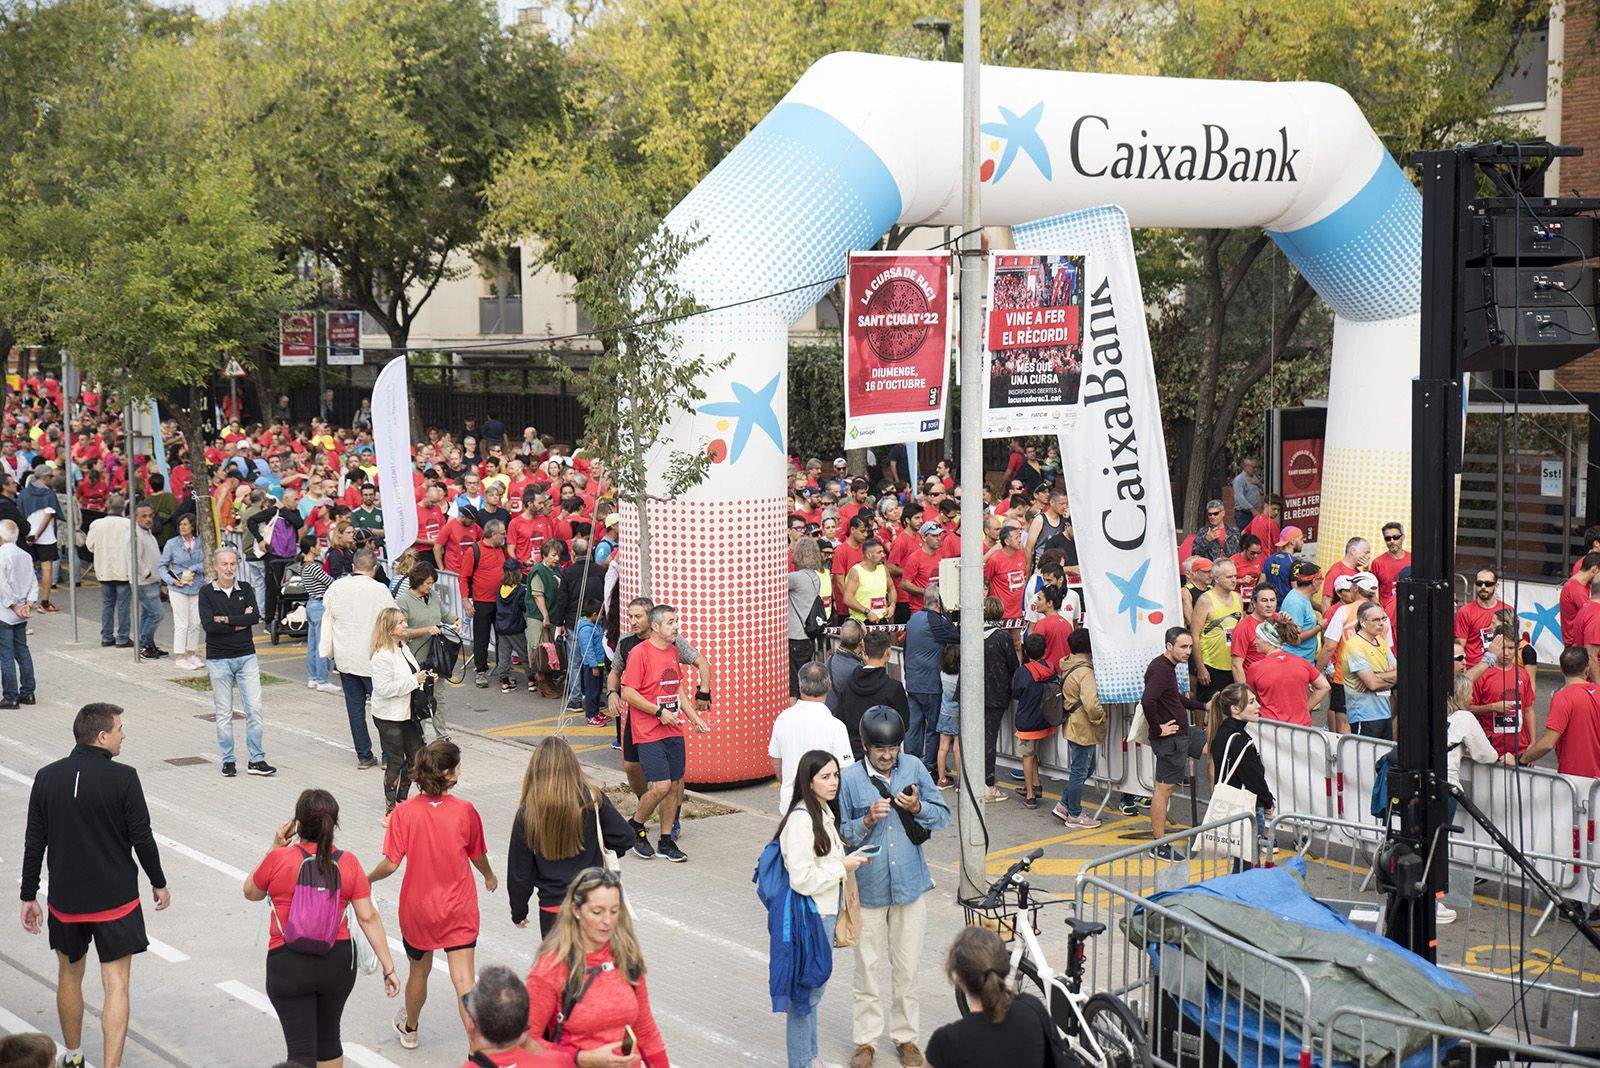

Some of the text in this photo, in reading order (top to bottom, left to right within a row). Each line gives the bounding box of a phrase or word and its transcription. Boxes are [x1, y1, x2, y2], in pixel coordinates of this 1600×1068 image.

[1069, 114, 1301, 183] CaixaBank
[860, 288, 874, 305] LA
[870, 266, 903, 291] CURSA
[903, 267, 917, 280] DE
[857, 314, 886, 328] SANT
[885, 312, 920, 326] CUGAT
[1005, 309, 1066, 327] VINE A FER
[1002, 326, 1069, 345] EL RÈCORD!
[871, 366, 919, 378] DIUMENGE,
[1036, 361, 1054, 373] QUE
[865, 378, 927, 392] 16 D'OCTUBRE
[1010, 373, 1060, 386] UNA CURSA
[1083, 275, 1148, 551] CaixaBank
[1542, 468, 1562, 479] Sst!
[1286, 495, 1320, 507] VINE A FER
[1284, 507, 1319, 520] EL RÈCORD
